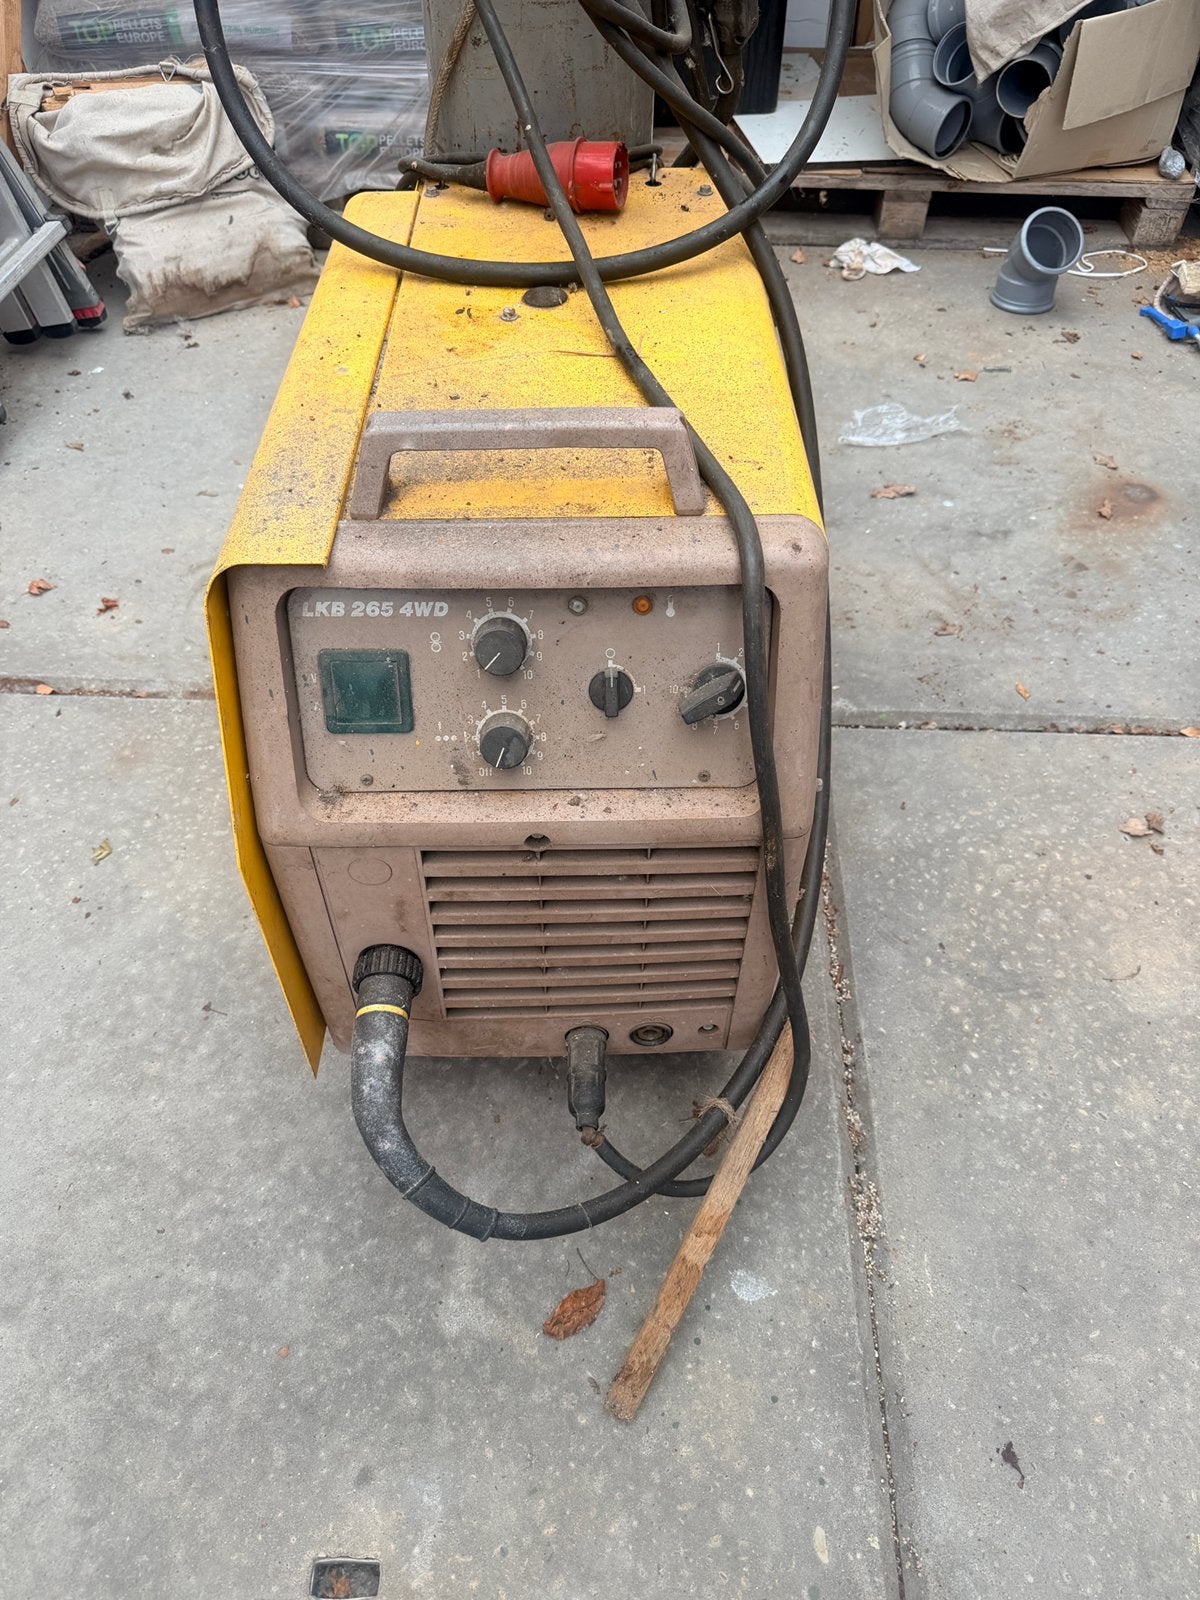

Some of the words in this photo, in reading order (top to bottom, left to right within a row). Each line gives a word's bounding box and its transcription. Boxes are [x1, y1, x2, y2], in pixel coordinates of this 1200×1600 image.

[113, 18, 163, 32] PELLETS
[116, 31, 166, 43] EUROPE
[486, 597, 492, 607] 5
[508, 597, 515, 607] 6
[302, 601, 346, 617] LKB
[351, 601, 394, 617] 265
[399, 601, 449, 617] 4WD
[466, 610, 472, 620] 4
[529, 610, 534, 619] 7
[458, 630, 465, 640] 3
[537, 629, 544, 640] 8
[462, 651, 468, 661] 2
[536, 651, 543, 661] 9
[738, 647, 744, 657] 2
[523, 669, 533, 680] 10
[669, 684, 679, 694] 10
[501, 694, 507, 704] 5
[521, 699, 527, 709] 6
[481, 700, 487, 710] 4
[467, 714, 474, 725] 3
[536, 713, 541, 723] 7
[713, 725, 718, 735] 7
[734, 720, 740, 730] 6
[541, 732, 547, 742] 8
[537, 751, 543, 760] 9
[479, 767, 493, 777] Off
[522, 766, 532, 776] 10
